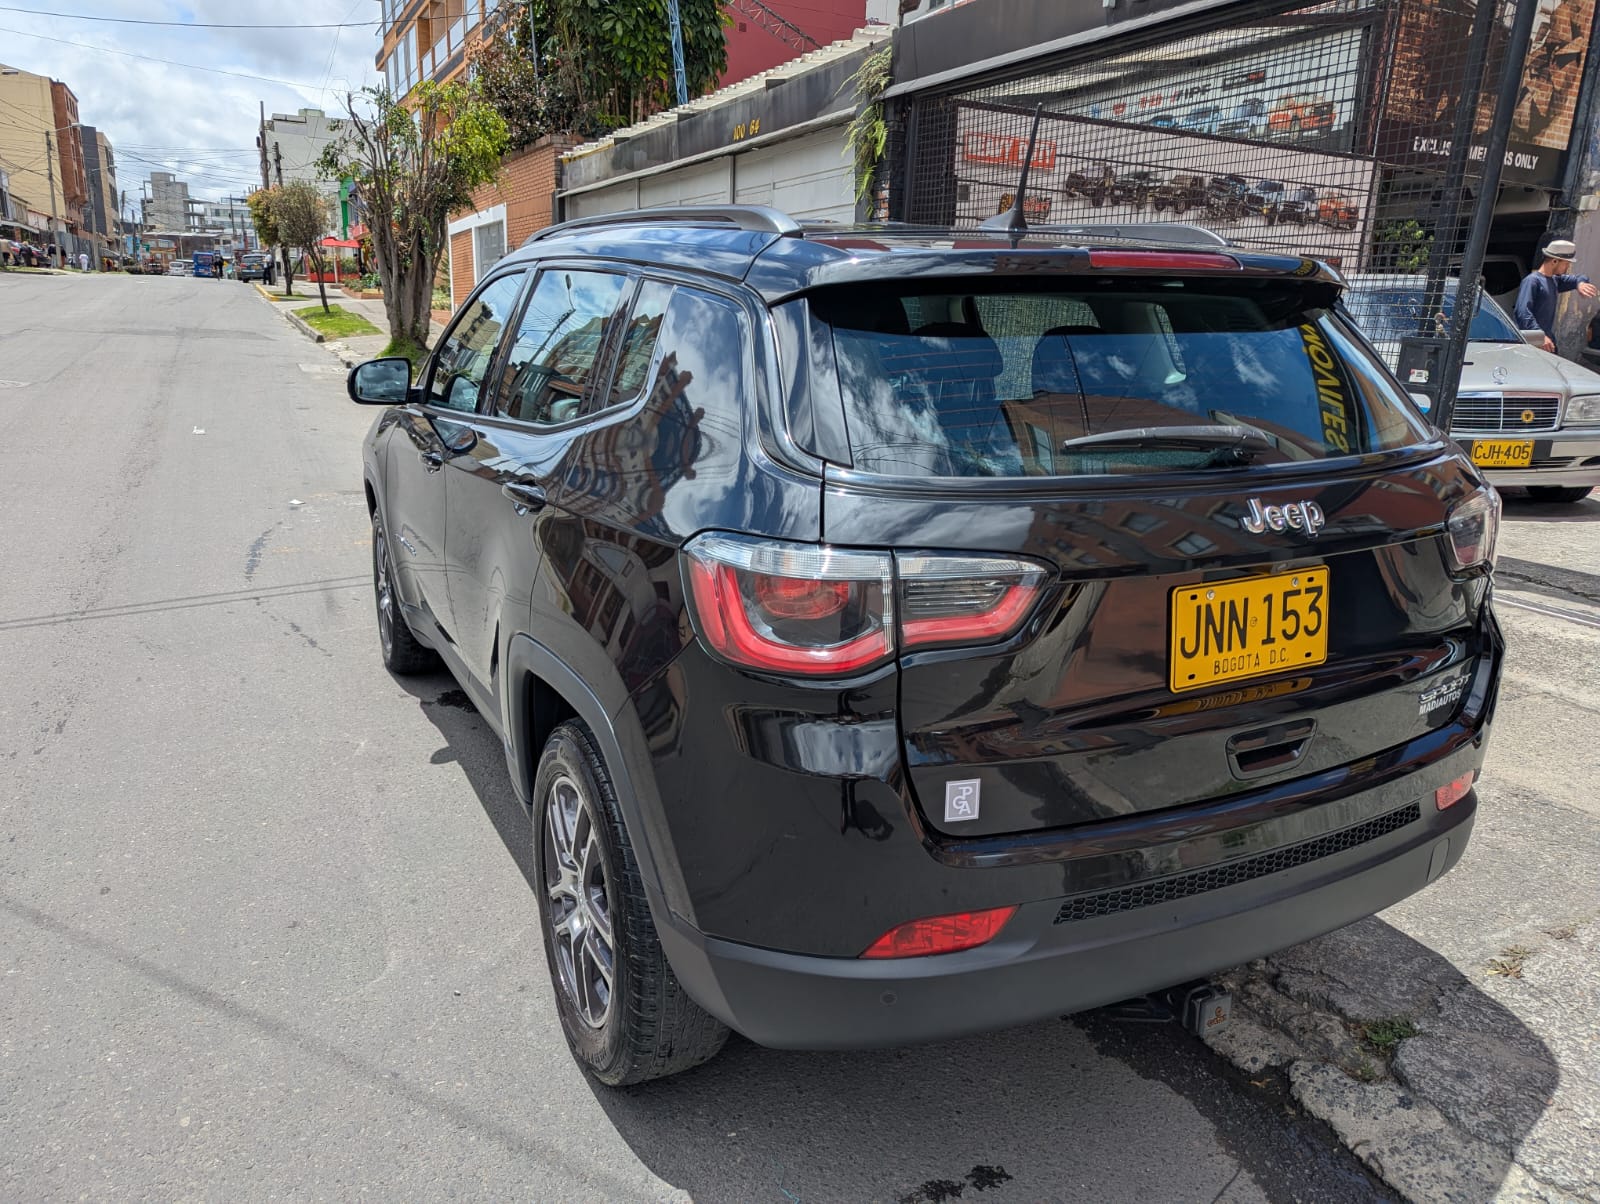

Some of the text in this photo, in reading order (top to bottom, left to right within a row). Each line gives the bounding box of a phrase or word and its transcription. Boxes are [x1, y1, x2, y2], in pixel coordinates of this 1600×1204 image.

[1514, 153, 1540, 170] ONLY
[1474, 445, 1531, 460] CJH-405
[1240, 498, 1325, 539] Jeep
[1180, 586, 1323, 660] JNN 153
[1214, 653, 1260, 676] BOGOTA
[1418, 689, 1461, 716] MADIAUTOS
